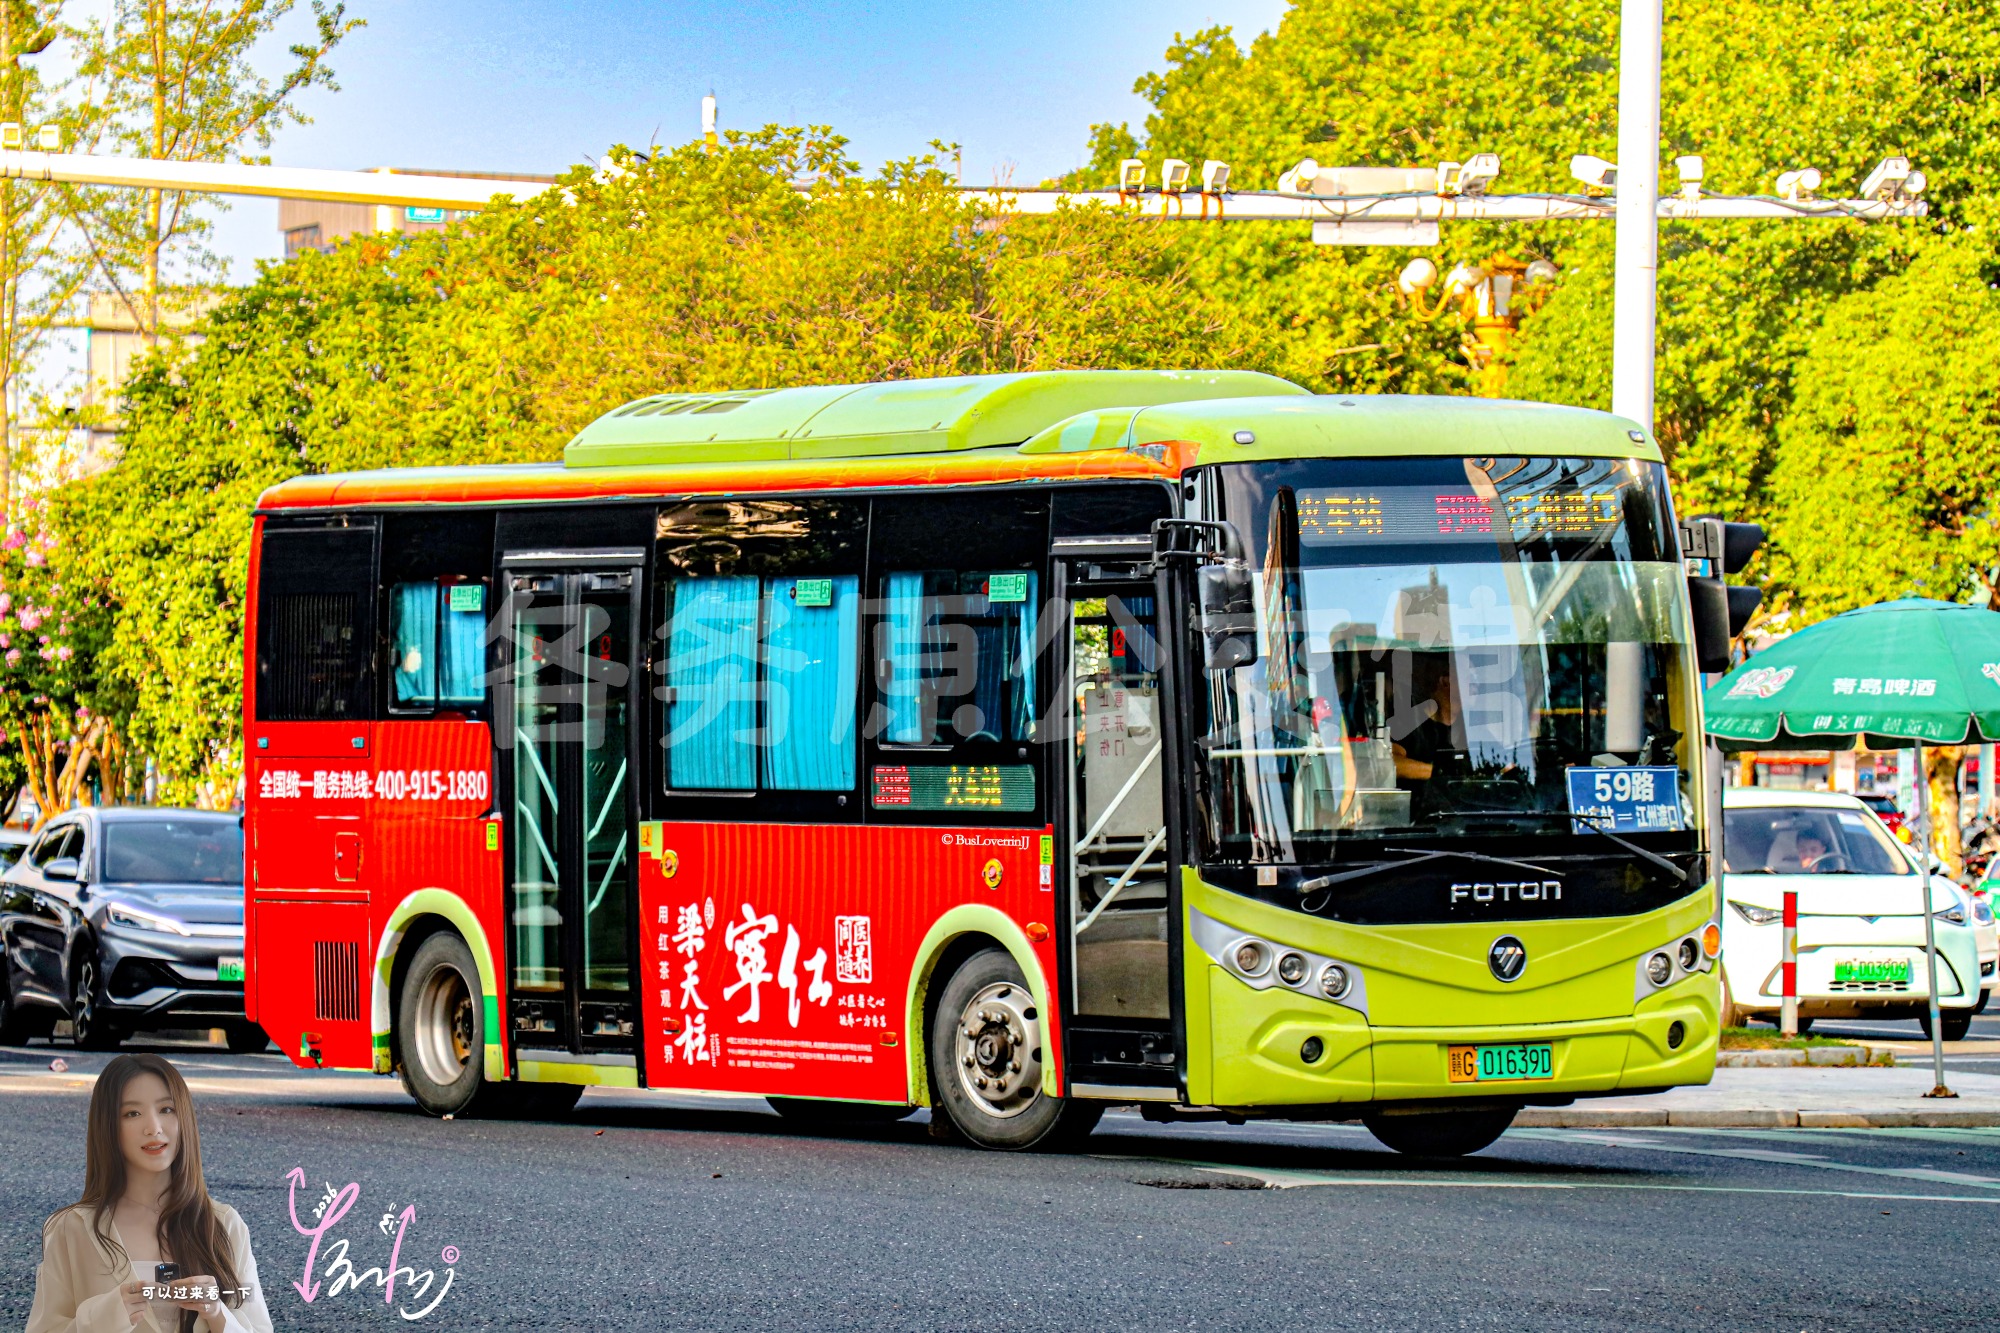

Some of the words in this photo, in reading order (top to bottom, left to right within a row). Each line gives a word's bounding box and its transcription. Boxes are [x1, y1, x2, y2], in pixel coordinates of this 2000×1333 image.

[1832, 678, 1937, 697] 青岛啤酒
[1594, 771, 1655, 802] 59路
[1451, 881, 1562, 903] FOTON
[671, 903, 710, 1066] 梁天柱
